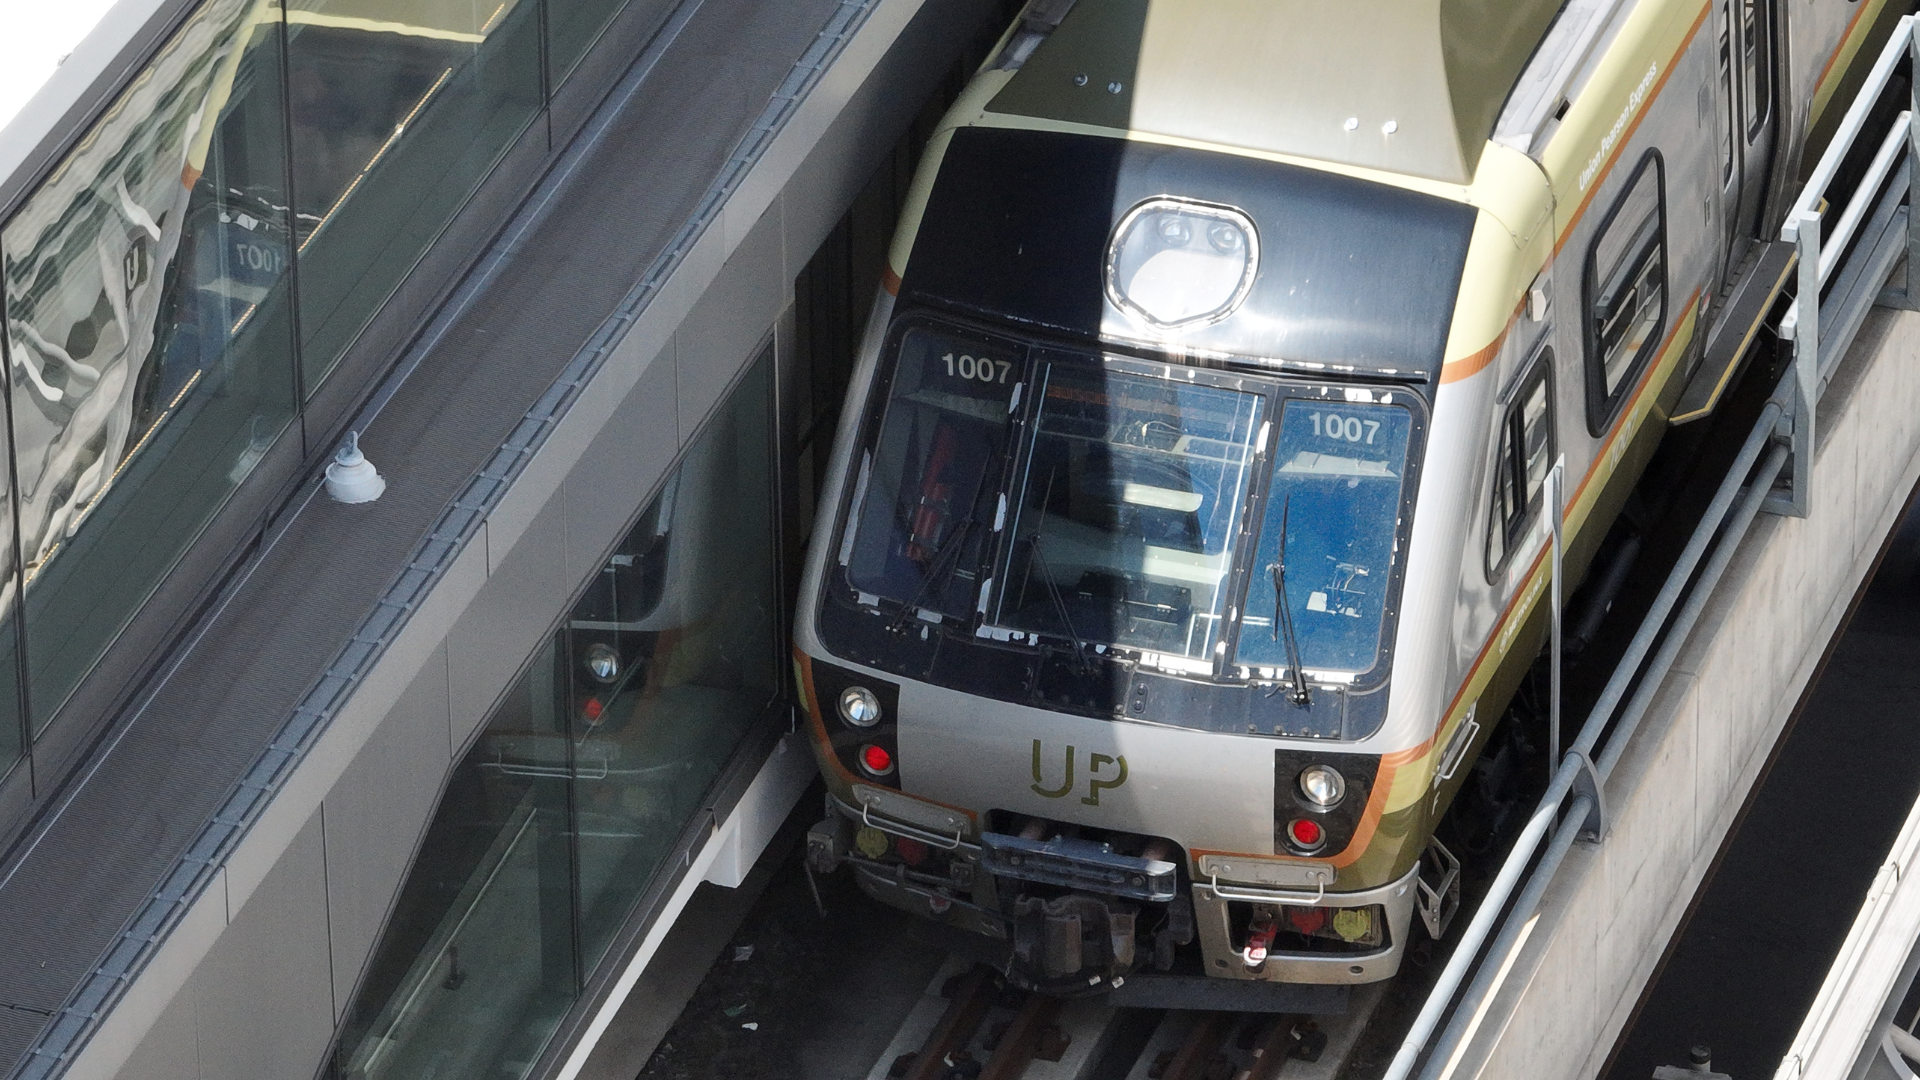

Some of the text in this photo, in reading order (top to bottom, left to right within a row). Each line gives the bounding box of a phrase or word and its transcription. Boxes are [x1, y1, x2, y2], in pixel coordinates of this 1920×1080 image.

[1579, 150, 1602, 191] Union
[1601, 106, 1629, 158] Pearson
[941, 352, 1012, 384] 1007
[1309, 411, 1381, 445] 1007
[1030, 738, 1129, 806] UP
